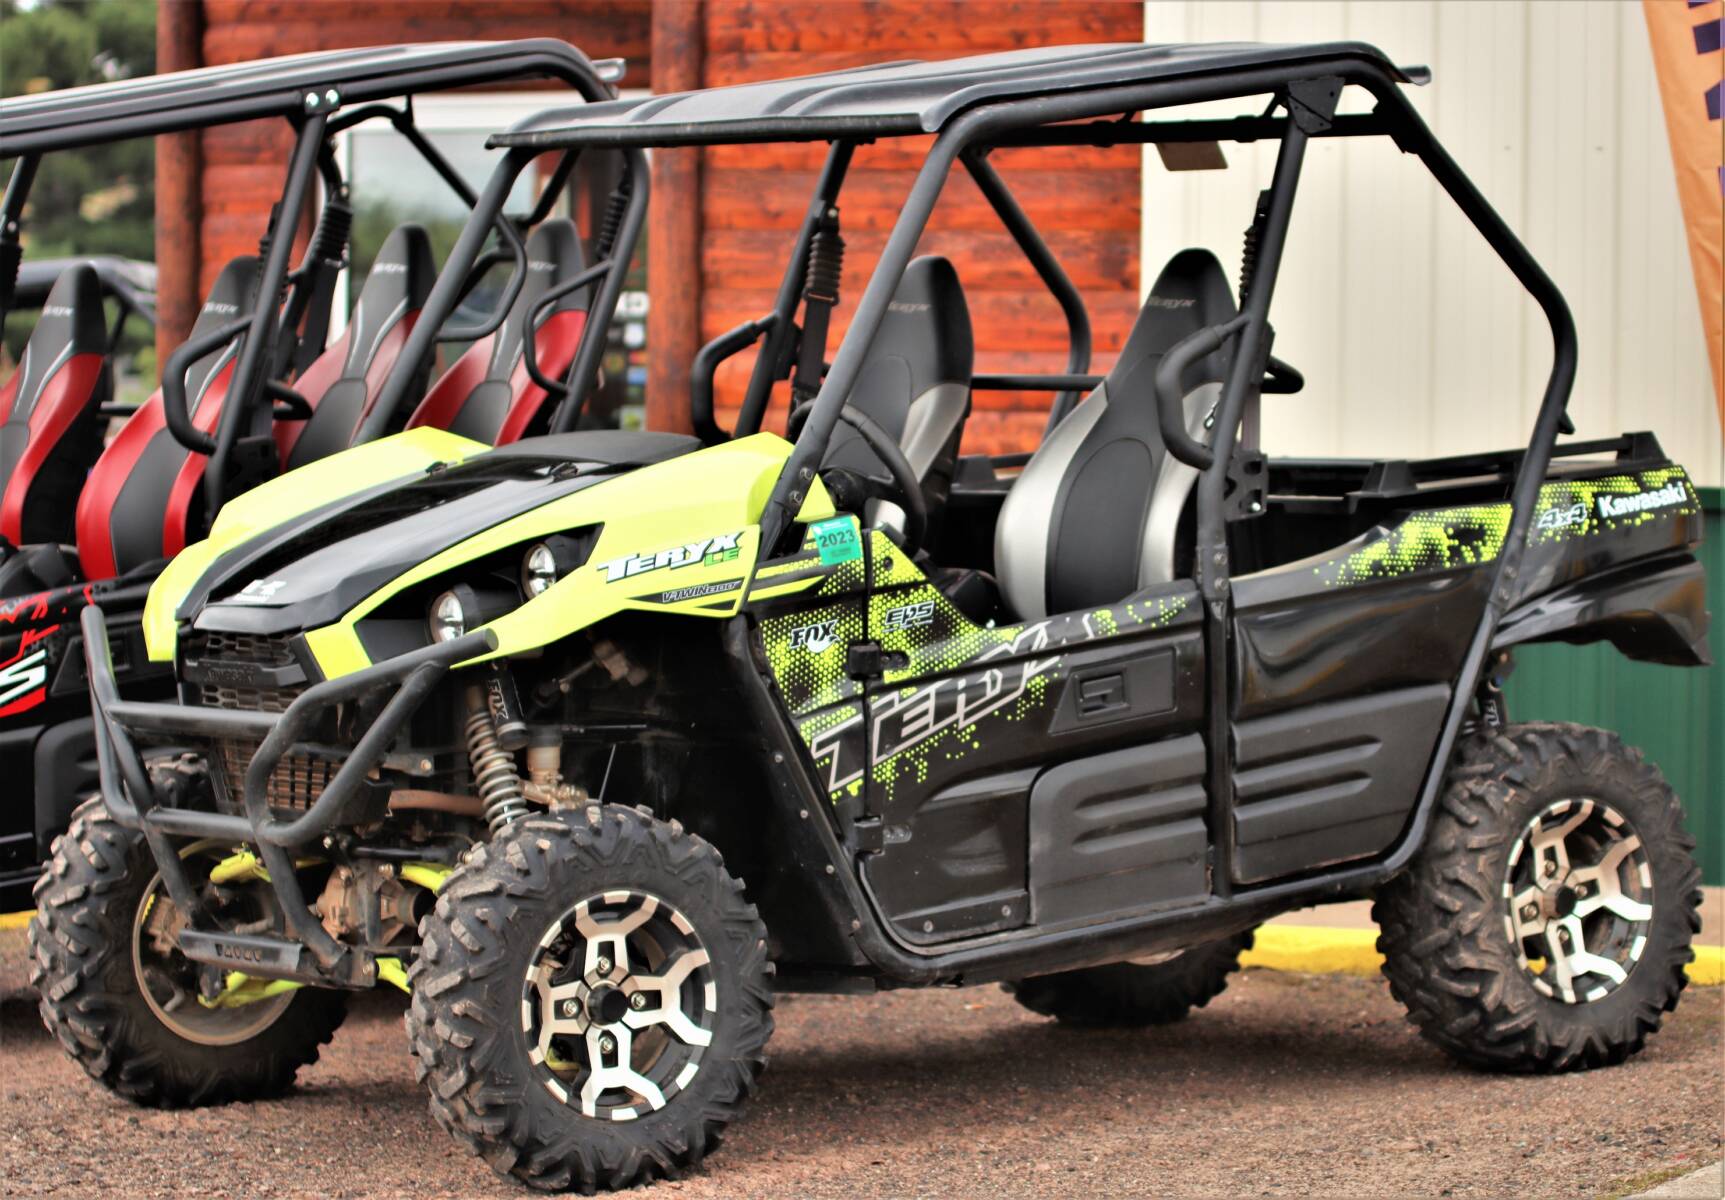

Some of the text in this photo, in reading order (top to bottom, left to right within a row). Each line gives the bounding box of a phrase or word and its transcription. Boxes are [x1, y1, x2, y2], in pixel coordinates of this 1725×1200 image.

[1598, 480, 1688, 518] Kawasaki
[1537, 503, 1588, 528] 4x4
[818, 528, 856, 549] 2023
[597, 530, 745, 584] TERYX
[704, 547, 742, 567] LE
[885, 600, 934, 627] EPS
[789, 618, 840, 652] FOX
